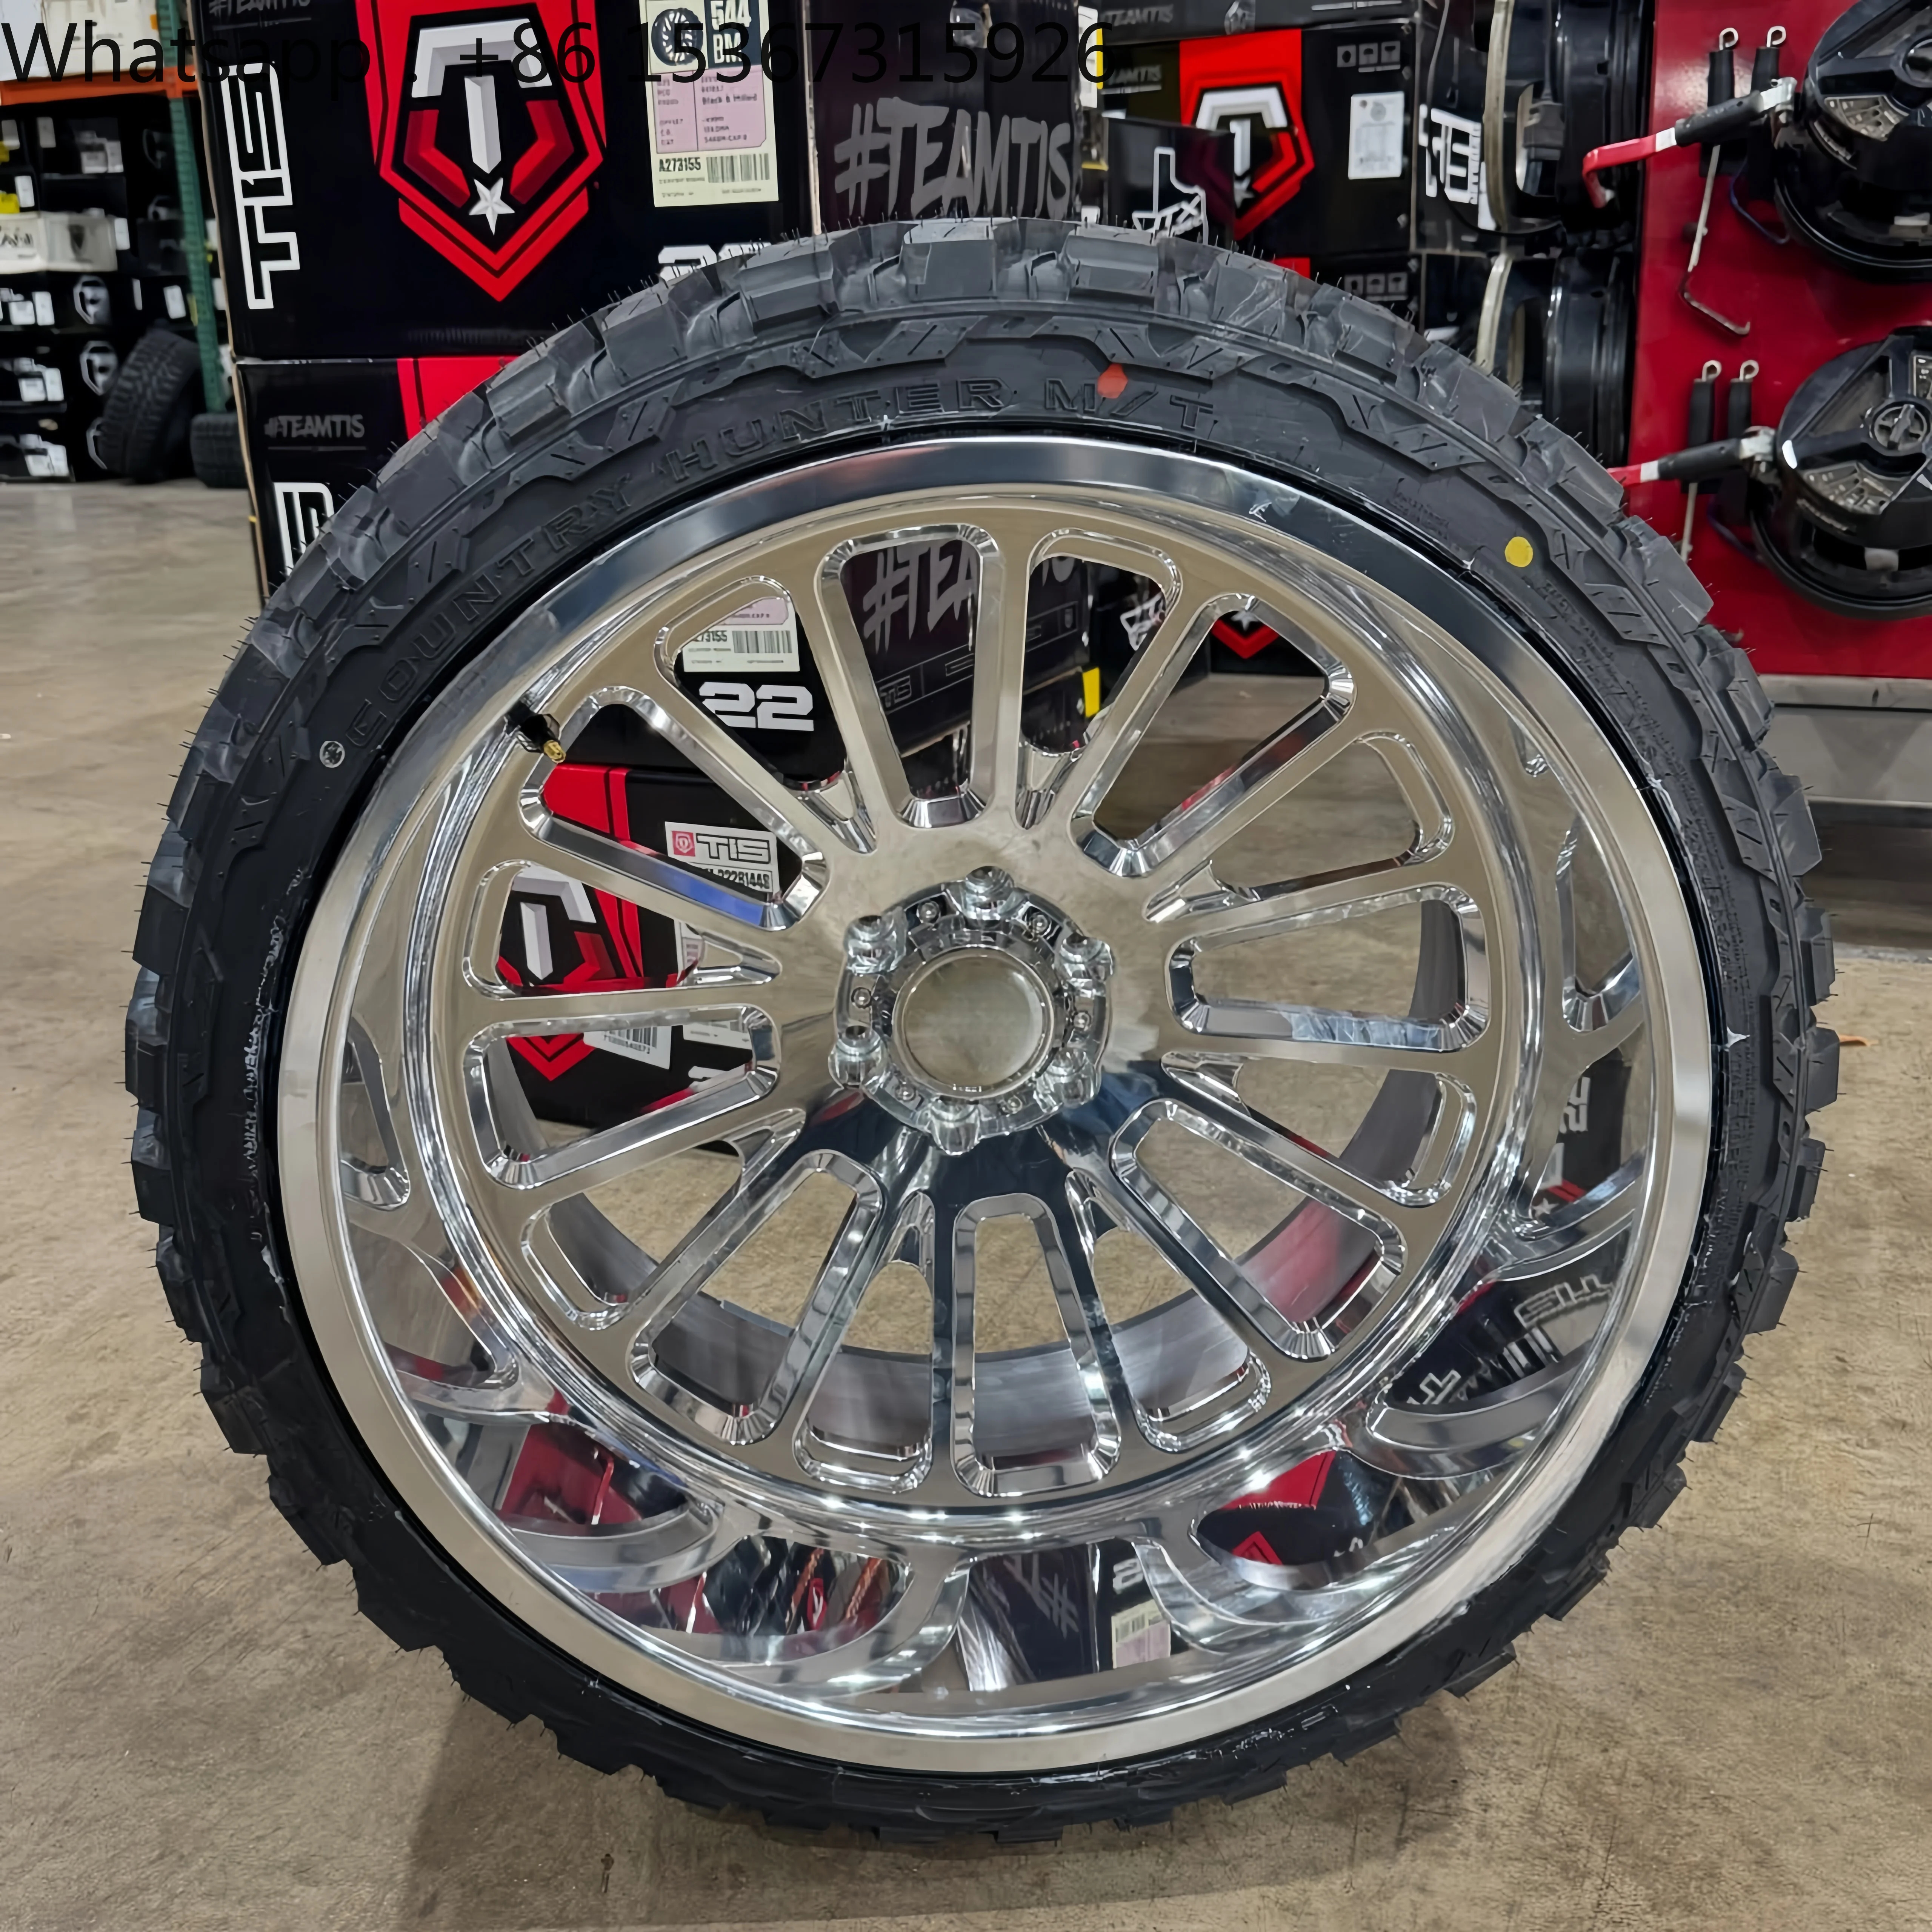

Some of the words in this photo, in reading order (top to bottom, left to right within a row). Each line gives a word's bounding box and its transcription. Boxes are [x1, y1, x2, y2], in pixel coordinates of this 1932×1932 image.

[834, 97, 1071, 220] #TEAMTIS
[265, 414, 365, 438] #TEAMTIS
[345, 473, 632, 749] COUNTRY
[665, 377, 1014, 483] HUNTER
[1044, 378, 1214, 431] M/T
[699, 681, 814, 732] 22
[696, 833, 771, 864] TIS
